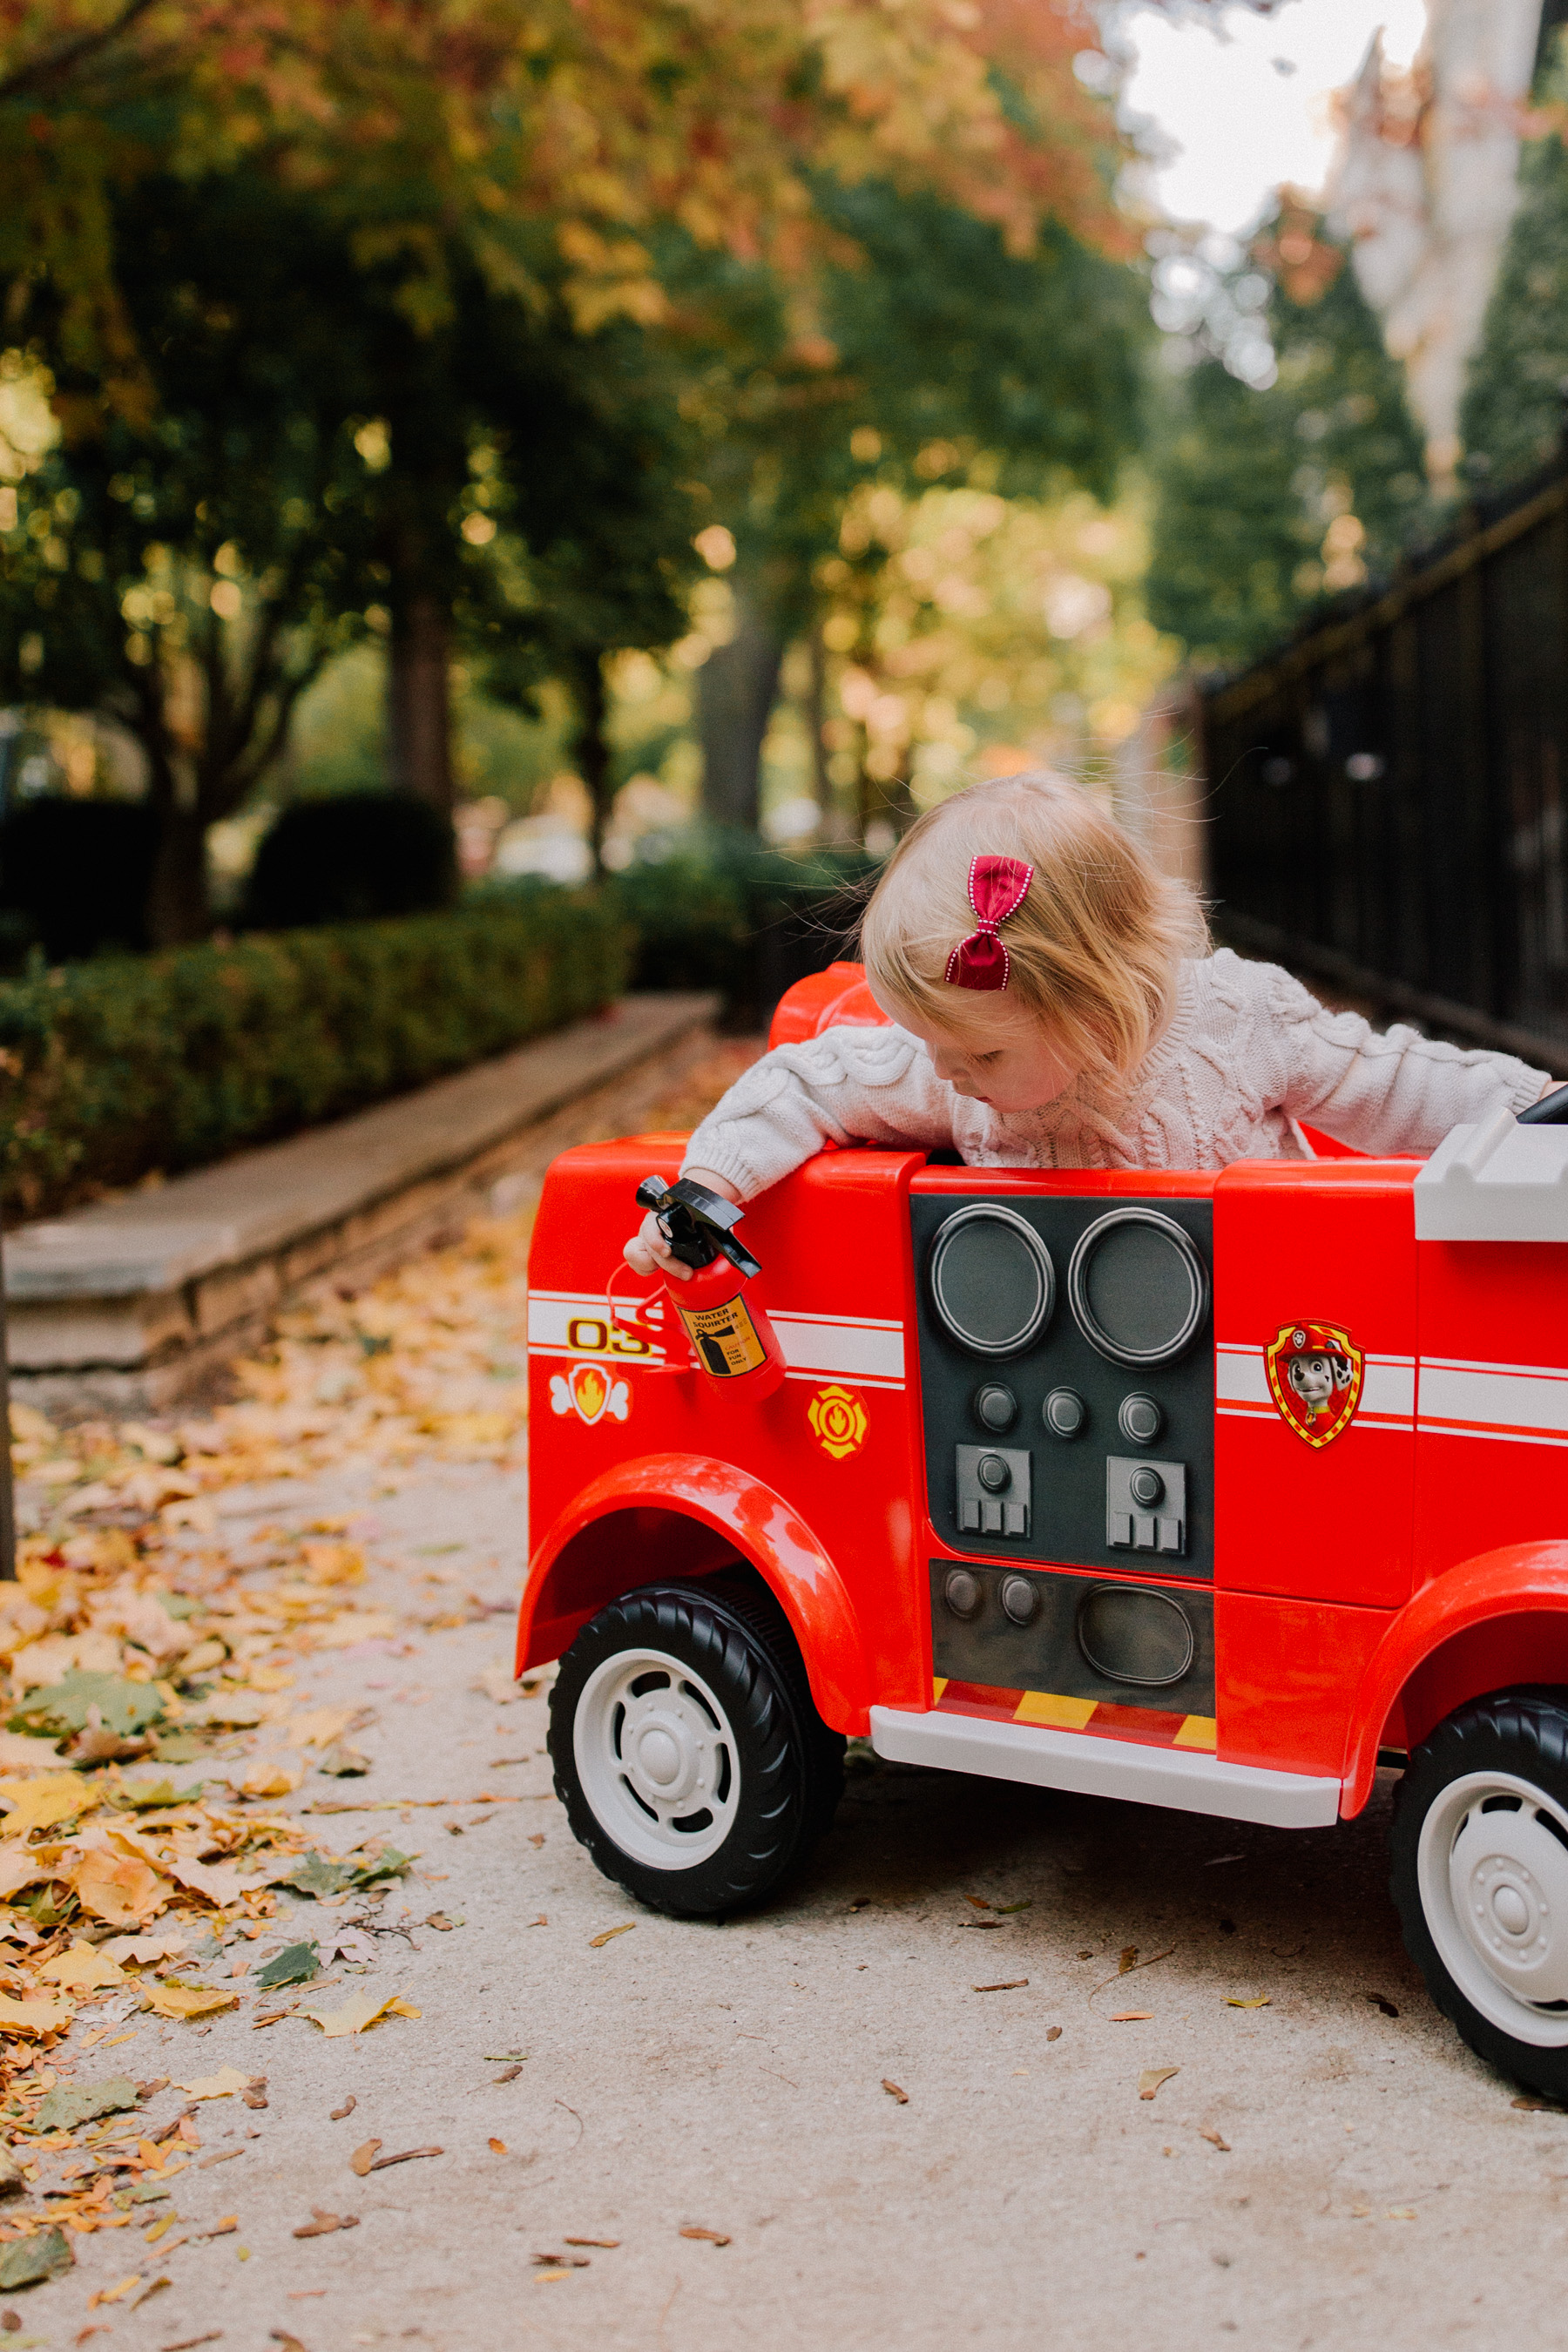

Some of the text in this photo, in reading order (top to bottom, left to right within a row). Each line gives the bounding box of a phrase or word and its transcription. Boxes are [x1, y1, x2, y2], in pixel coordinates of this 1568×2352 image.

[693, 1312, 739, 1328] SQUIRTER
[694, 1308, 729, 1321] WATER
[731, 1357, 747, 1366] ONLY
